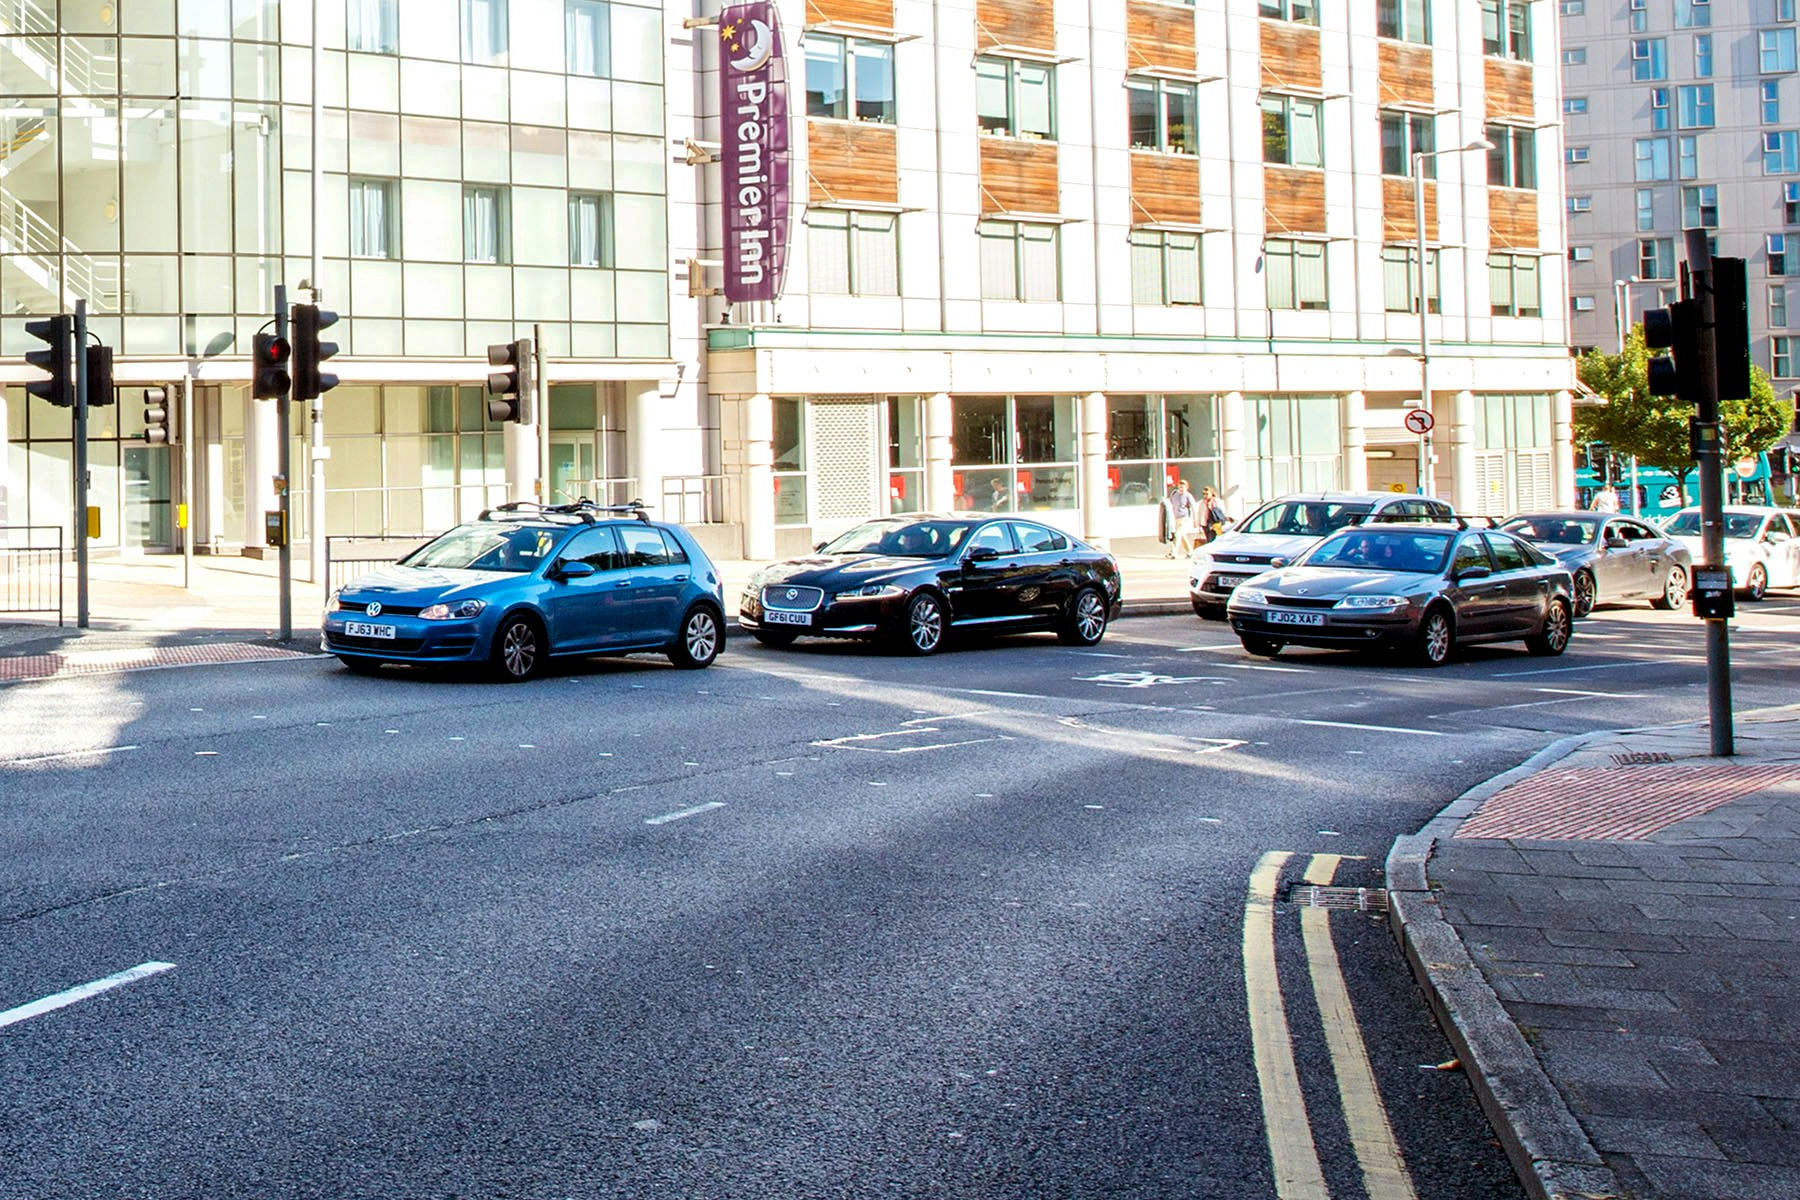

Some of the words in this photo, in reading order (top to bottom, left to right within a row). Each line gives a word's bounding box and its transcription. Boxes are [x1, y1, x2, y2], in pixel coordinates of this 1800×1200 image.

[737, 81, 768, 226] Premier
[740, 230, 769, 284] Inn
[768, 612, 788, 623] GF61
[788, 614, 807, 624] CUU
[1270, 612, 1297, 623] FJ02
[1298, 613, 1319, 624] XAF
[348, 623, 372, 635] FJ63
[373, 625, 392, 637] WHC
